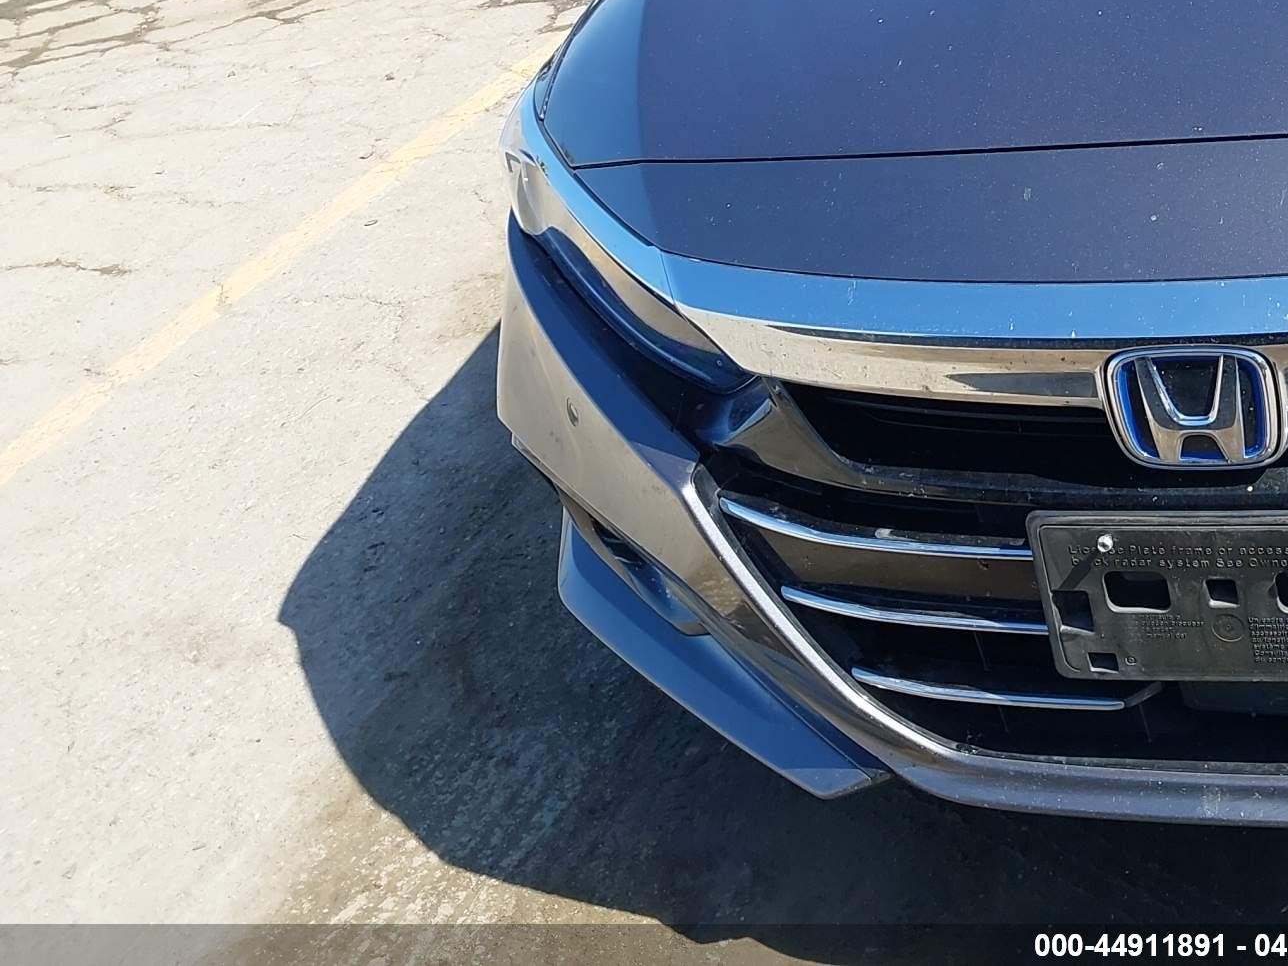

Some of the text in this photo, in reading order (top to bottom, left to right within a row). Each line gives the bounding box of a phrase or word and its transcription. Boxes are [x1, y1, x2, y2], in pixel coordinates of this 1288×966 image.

[1068, 544, 1125, 556] Licese
[1129, 544, 1167, 555] Plate
[1071, 555, 1110, 567] bck
[1114, 557, 1152, 567] radar
[1158, 557, 1210, 569] system
[1215, 556, 1243, 568] See
